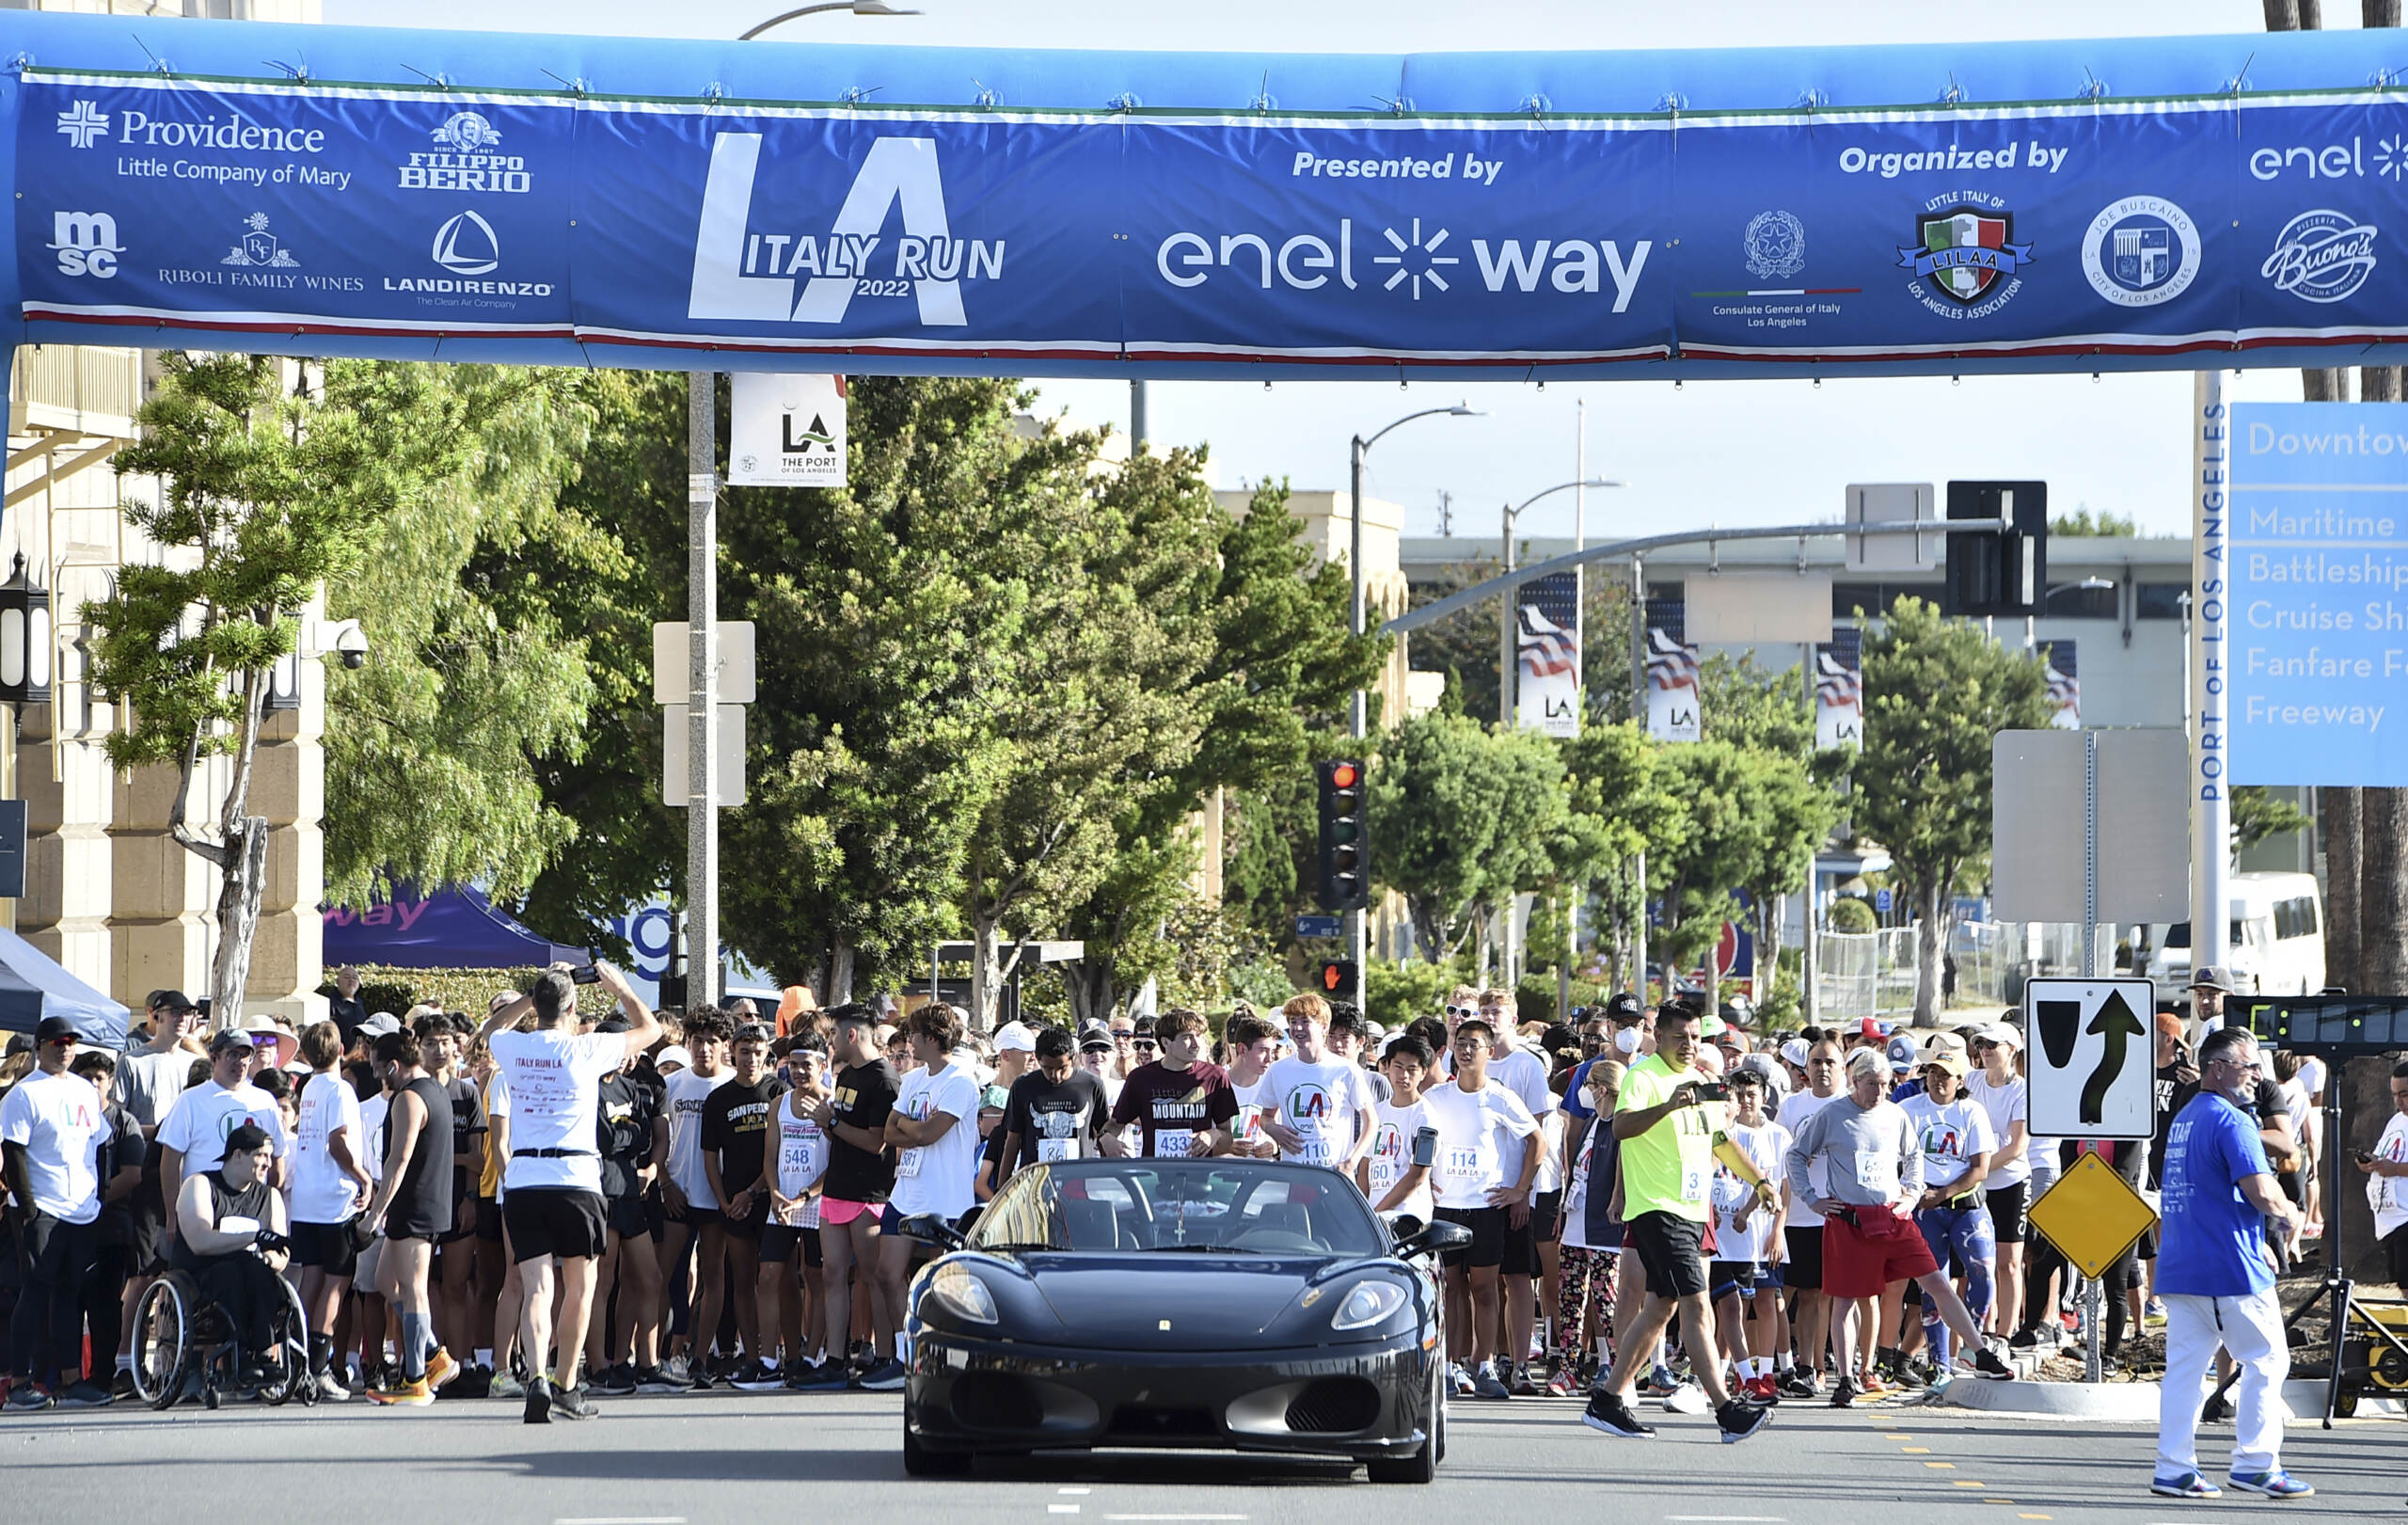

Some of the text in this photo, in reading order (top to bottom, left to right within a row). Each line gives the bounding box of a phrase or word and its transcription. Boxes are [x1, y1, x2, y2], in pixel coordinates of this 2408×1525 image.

[120, 110, 325, 153] Providence
[409, 152, 524, 170] FILIPPO
[1291, 151, 1503, 184] Presented by
[1839, 141, 2068, 179] Organized by
[2249, 135, 2365, 181] enel
[118, 158, 352, 191] Little Company of Mary
[398, 167, 531, 193] BERIO
[1925, 190, 2005, 211] LITTLE ITALY OF
[2095, 200, 2188, 235] JOE BUSCAINO
[2296, 216, 2337, 233] PIZZERIA
[688, 133, 968, 326] LA
[746, 233, 1006, 279] ITALY RUN
[1157, 218, 1652, 313] enel way
[1930, 250, 1998, 269] LILAA
[159, 269, 364, 292] RIBOLI FAMILY WINES
[384, 278, 552, 297] LANDIRENZO
[857, 279, 911, 297] 2022
[2093, 267, 2192, 303] CITY OF LOS ANGELES
[417, 296, 517, 310] The Clean Air Company
[1713, 303, 1841, 316] Consulate General of Italy
[1907, 278, 2022, 320] LOS ANGELES ASSOCIATION
[1748, 317, 1807, 328] Los Angeles
[783, 412, 835, 453] LA
[783, 457, 836, 467] THE PORT
[2249, 507, 2396, 536] Maritime
[2200, 404, 2226, 802] PORT OF LOS ANGELES
[2248, 601, 2353, 631] Cruise
[2247, 647, 2408, 677] Fanfare F
[1545, 696, 1572, 718] LA
[1671, 708, 1693, 725] LA
[2246, 695, 2384, 732] Freeway
[515, 1057, 562, 1069] ITALY RUN LA
[1151, 1088, 1182, 1097] little
[66, 1104, 90, 1127] LA
[1152, 1104, 1206, 1120] MOUNTAIN
[1293, 1092, 1323, 1118] LA
[1161, 1136, 1187, 1152] 433
[1304, 1143, 1330, 1158] 110
[1374, 1132, 1394, 1155] LA
[1925, 1131, 1957, 1156] LA
[785, 1150, 809, 1164] 548
[1451, 1152, 1477, 1168] 114
